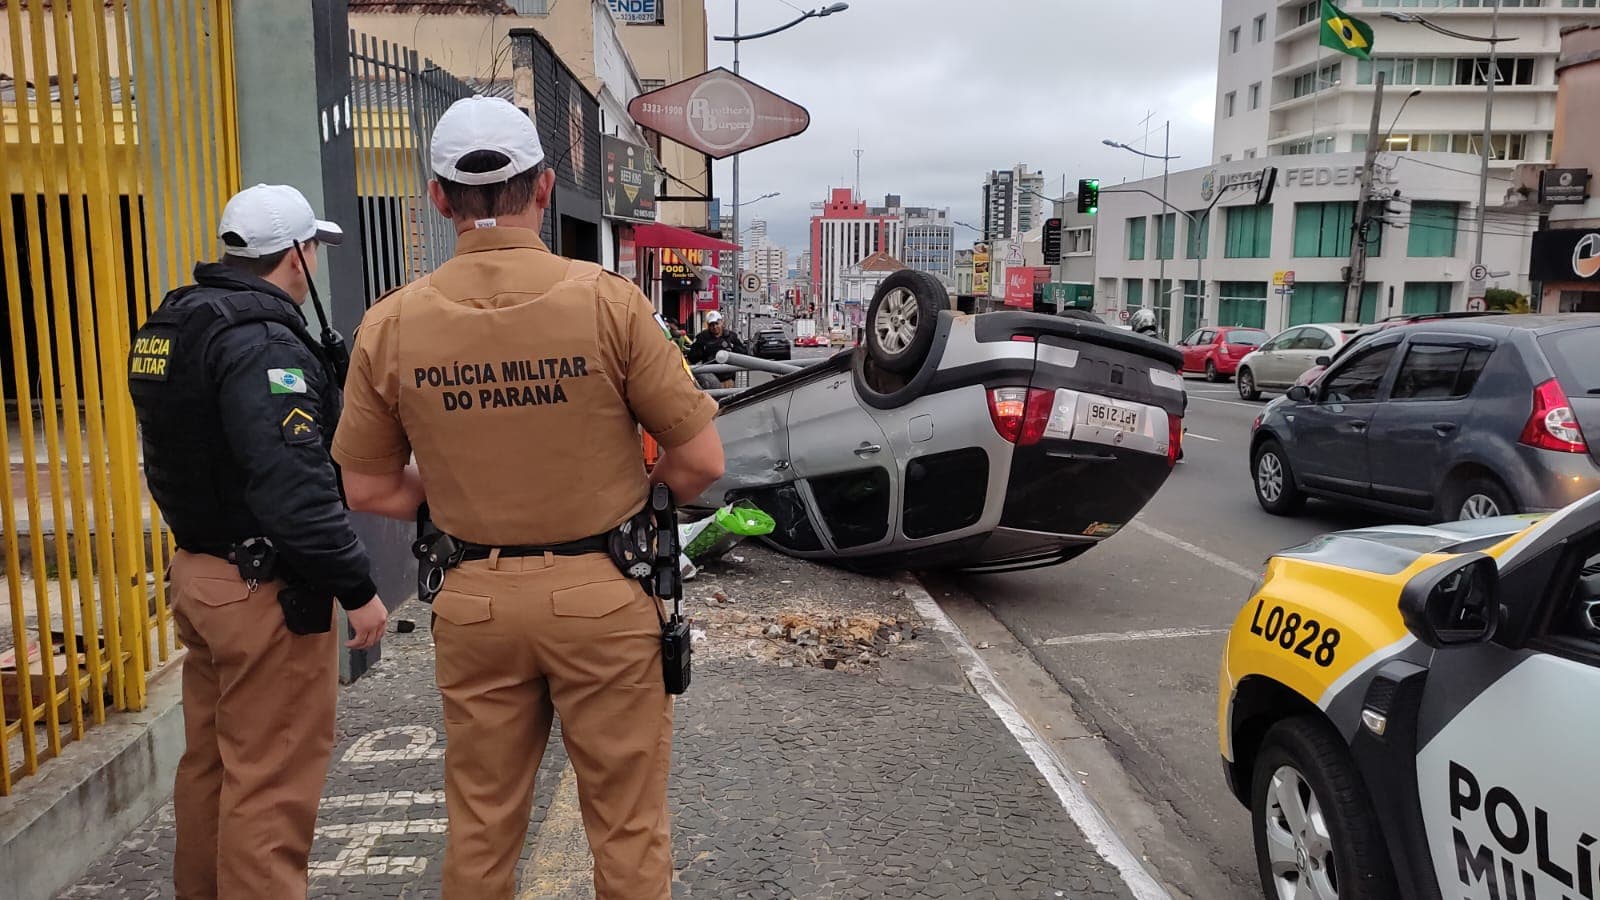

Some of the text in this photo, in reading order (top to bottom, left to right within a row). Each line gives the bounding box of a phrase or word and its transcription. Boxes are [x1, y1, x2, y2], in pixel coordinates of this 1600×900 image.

[1217, 169, 1280, 193] JUSTIÇ
[748, 277, 755, 289] E
[1475, 268, 1482, 278] E
[134, 335, 170, 356] POLÍCIA
[131, 357, 166, 376] MILITAR
[414, 356, 588, 388] POLÍCIA MILITAR
[442, 379, 568, 411] DO PARANÁ
[1092, 405, 1118, 421] 2196
[1250, 599, 1341, 668] L0828
[1449, 760, 1600, 900] POLÍ
